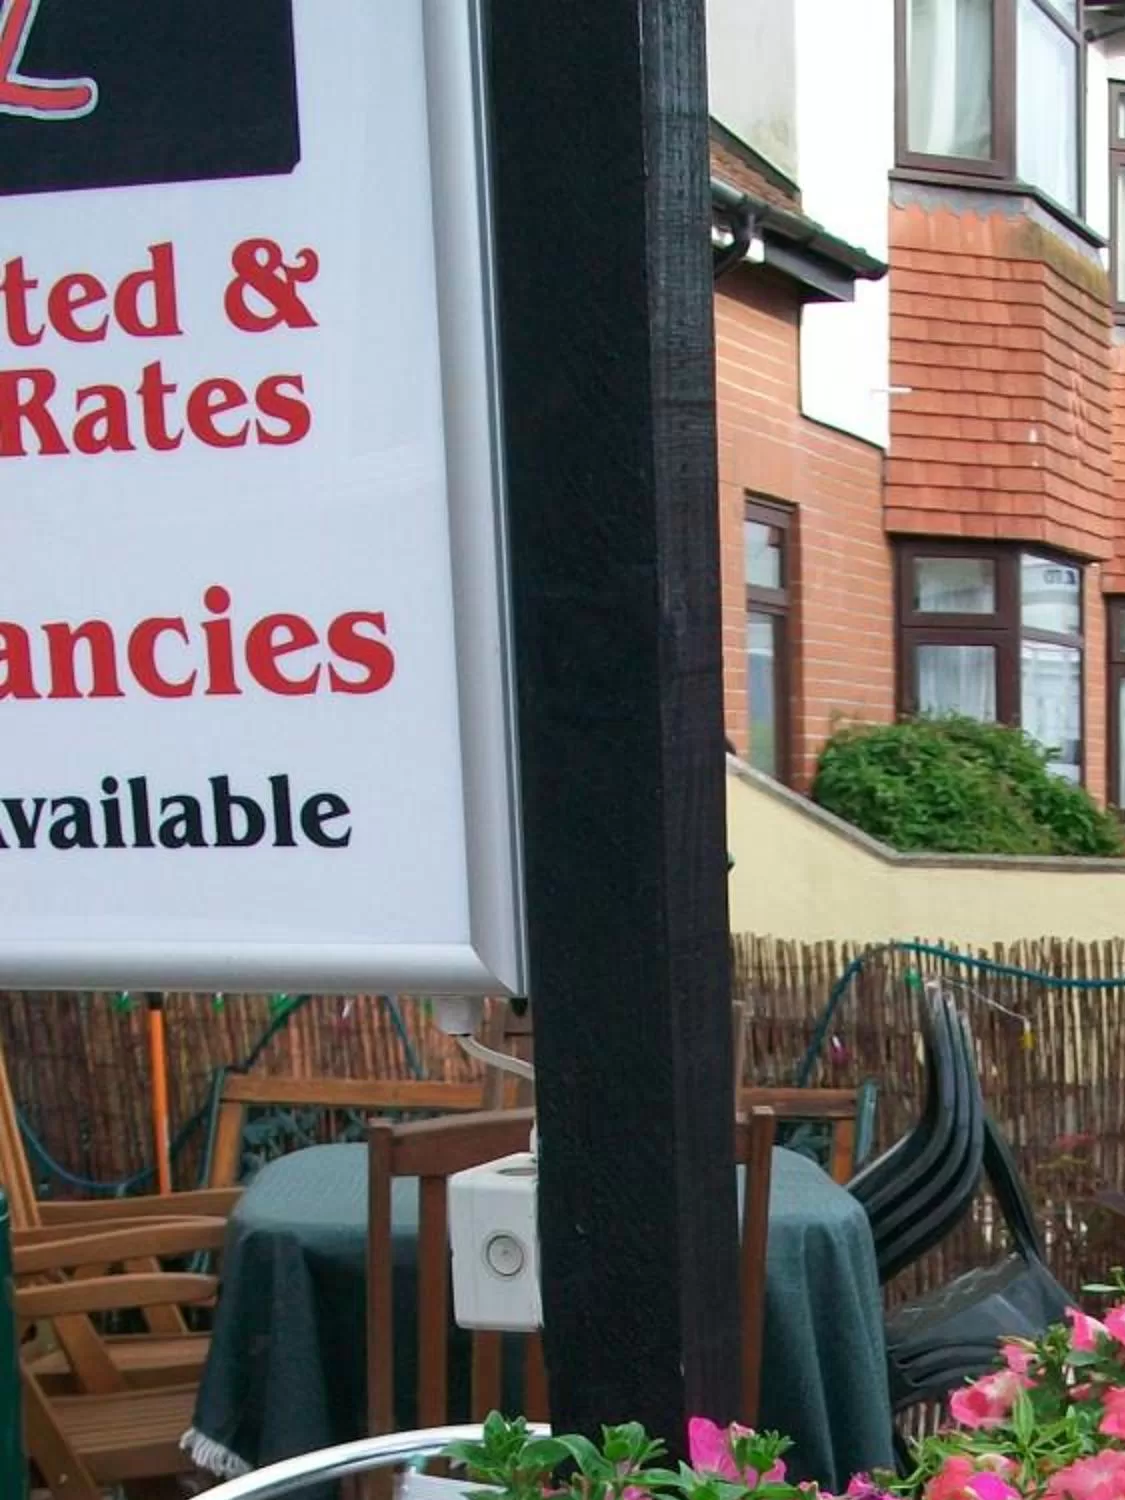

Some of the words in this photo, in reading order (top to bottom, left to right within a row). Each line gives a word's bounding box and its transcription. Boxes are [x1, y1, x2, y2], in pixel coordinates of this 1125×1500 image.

[0, 241, 183, 347] ted
[223, 238, 319, 332] &
[0, 360, 311, 457] Rates
[0, 584, 395, 699] ancies
[0, 774, 352, 851] vailable
